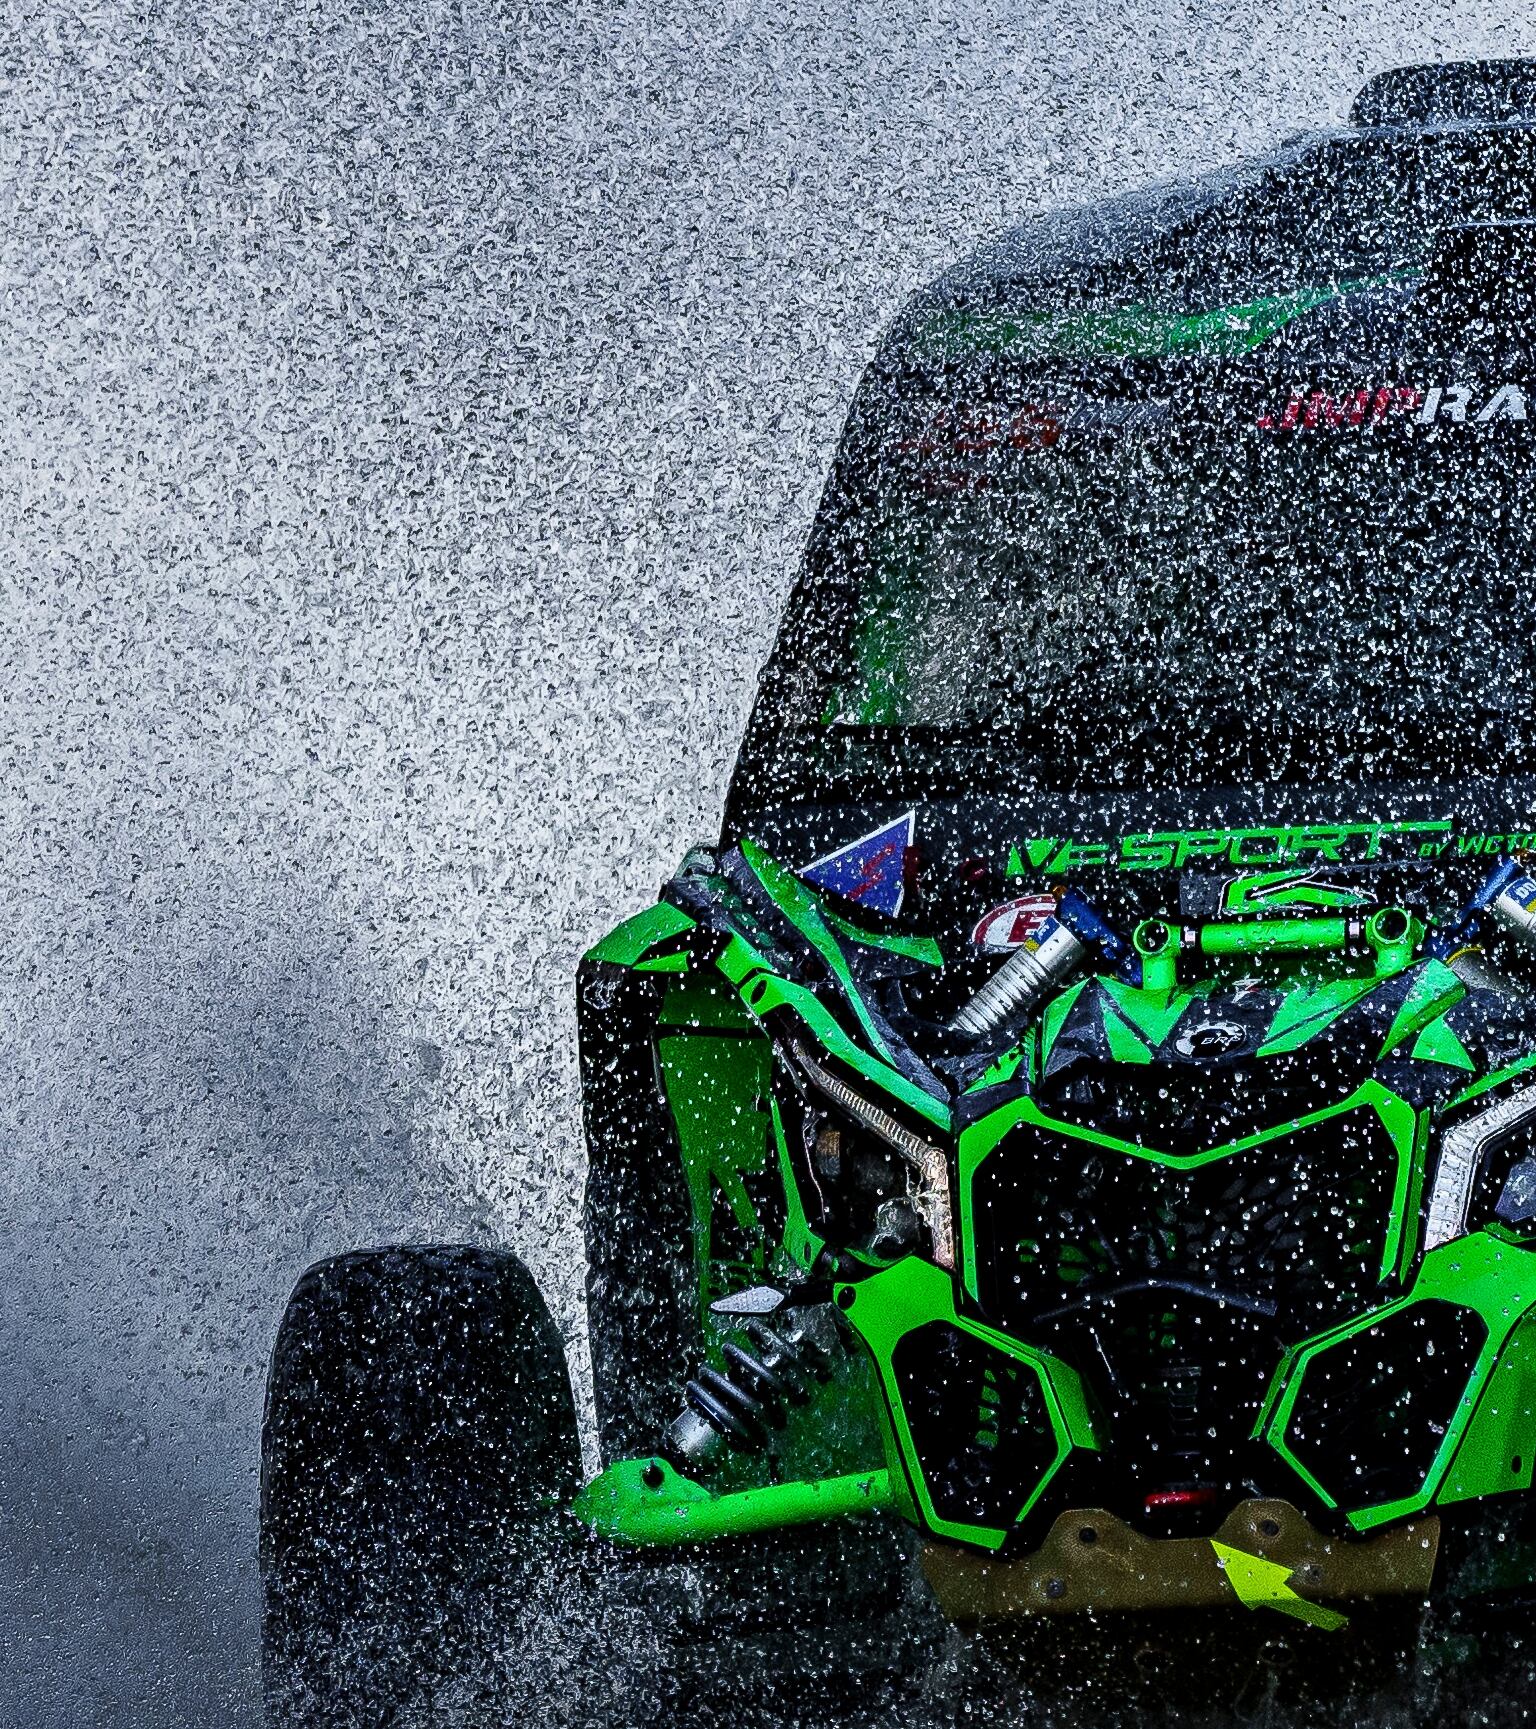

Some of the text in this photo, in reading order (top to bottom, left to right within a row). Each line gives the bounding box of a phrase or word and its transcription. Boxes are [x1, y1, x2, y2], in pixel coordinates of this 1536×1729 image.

[1118, 820, 1452, 873] SPORT
[1418, 842, 1449, 857] BY
[1201, 1035, 1241, 1047] BRP
